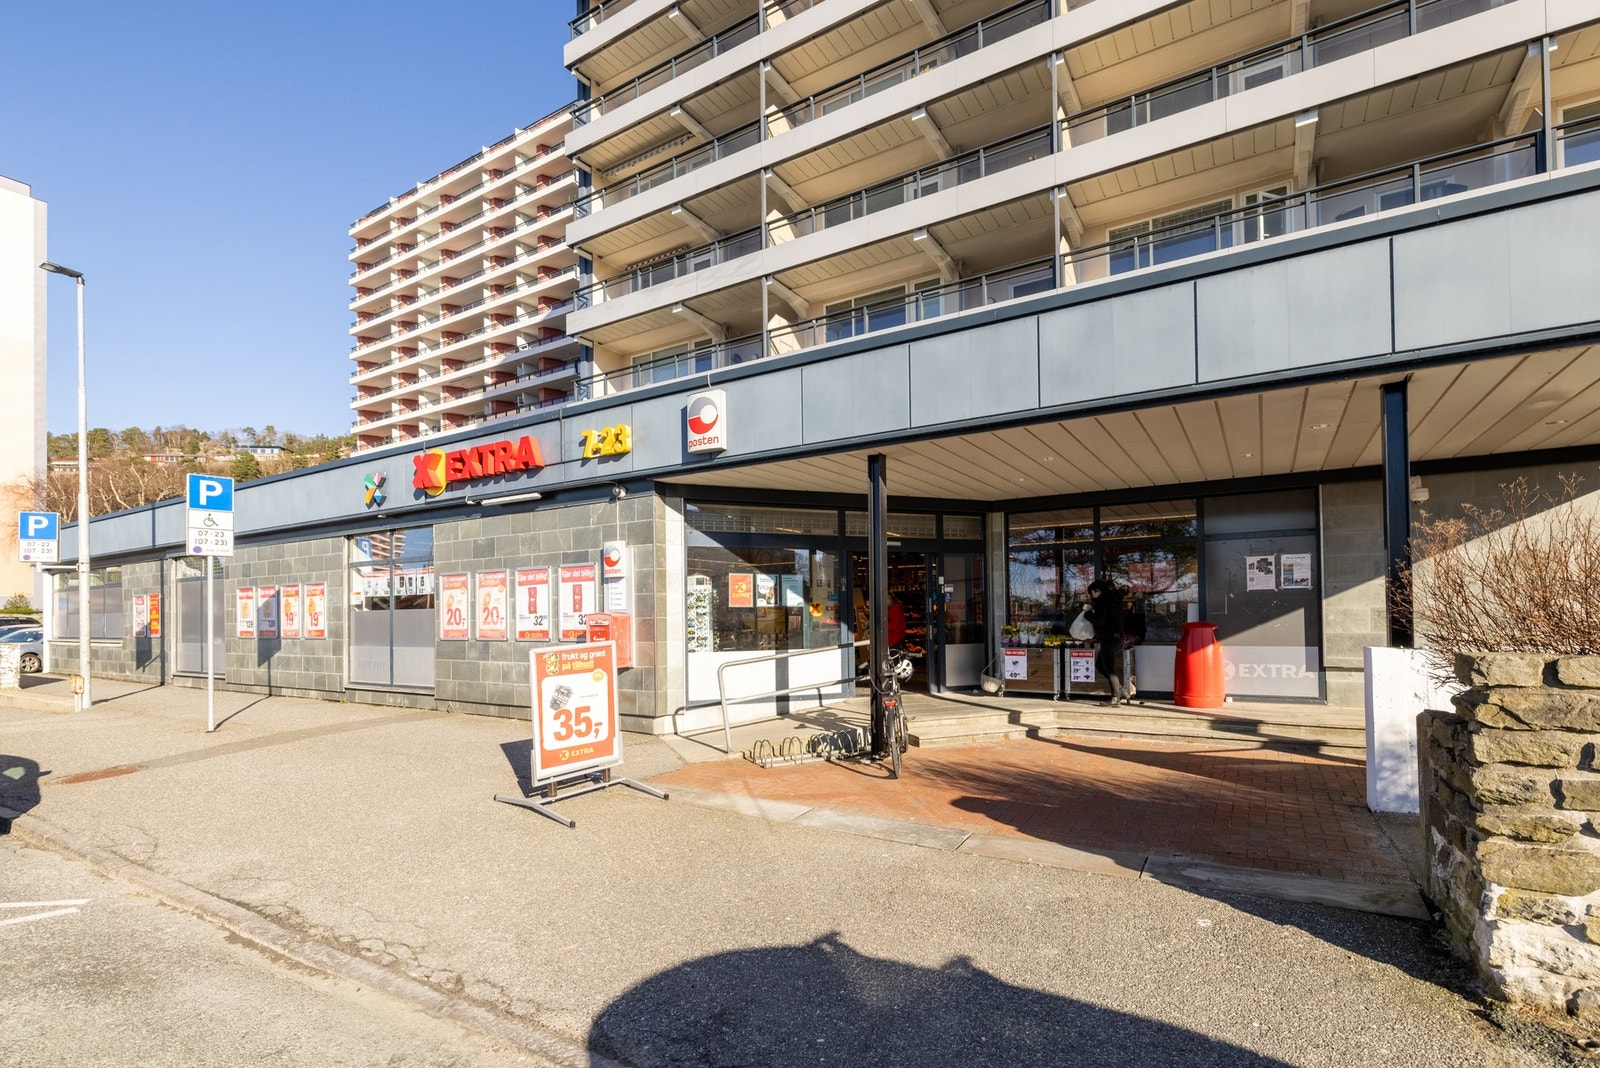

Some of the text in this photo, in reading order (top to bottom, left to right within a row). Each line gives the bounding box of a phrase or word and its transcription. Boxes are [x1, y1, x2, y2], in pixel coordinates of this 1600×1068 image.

[581, 424, 632, 458] 7-23
[688, 435, 719, 450] posten
[445, 435, 544, 481] EXTRA
[199, 479, 223, 506] P
[28, 515, 49, 537] P
[562, 652, 579, 660] frukt
[579, 652, 589, 660] og
[1238, 663, 1315, 679] EXTRA
[571, 746, 594, 757] EXTRA
